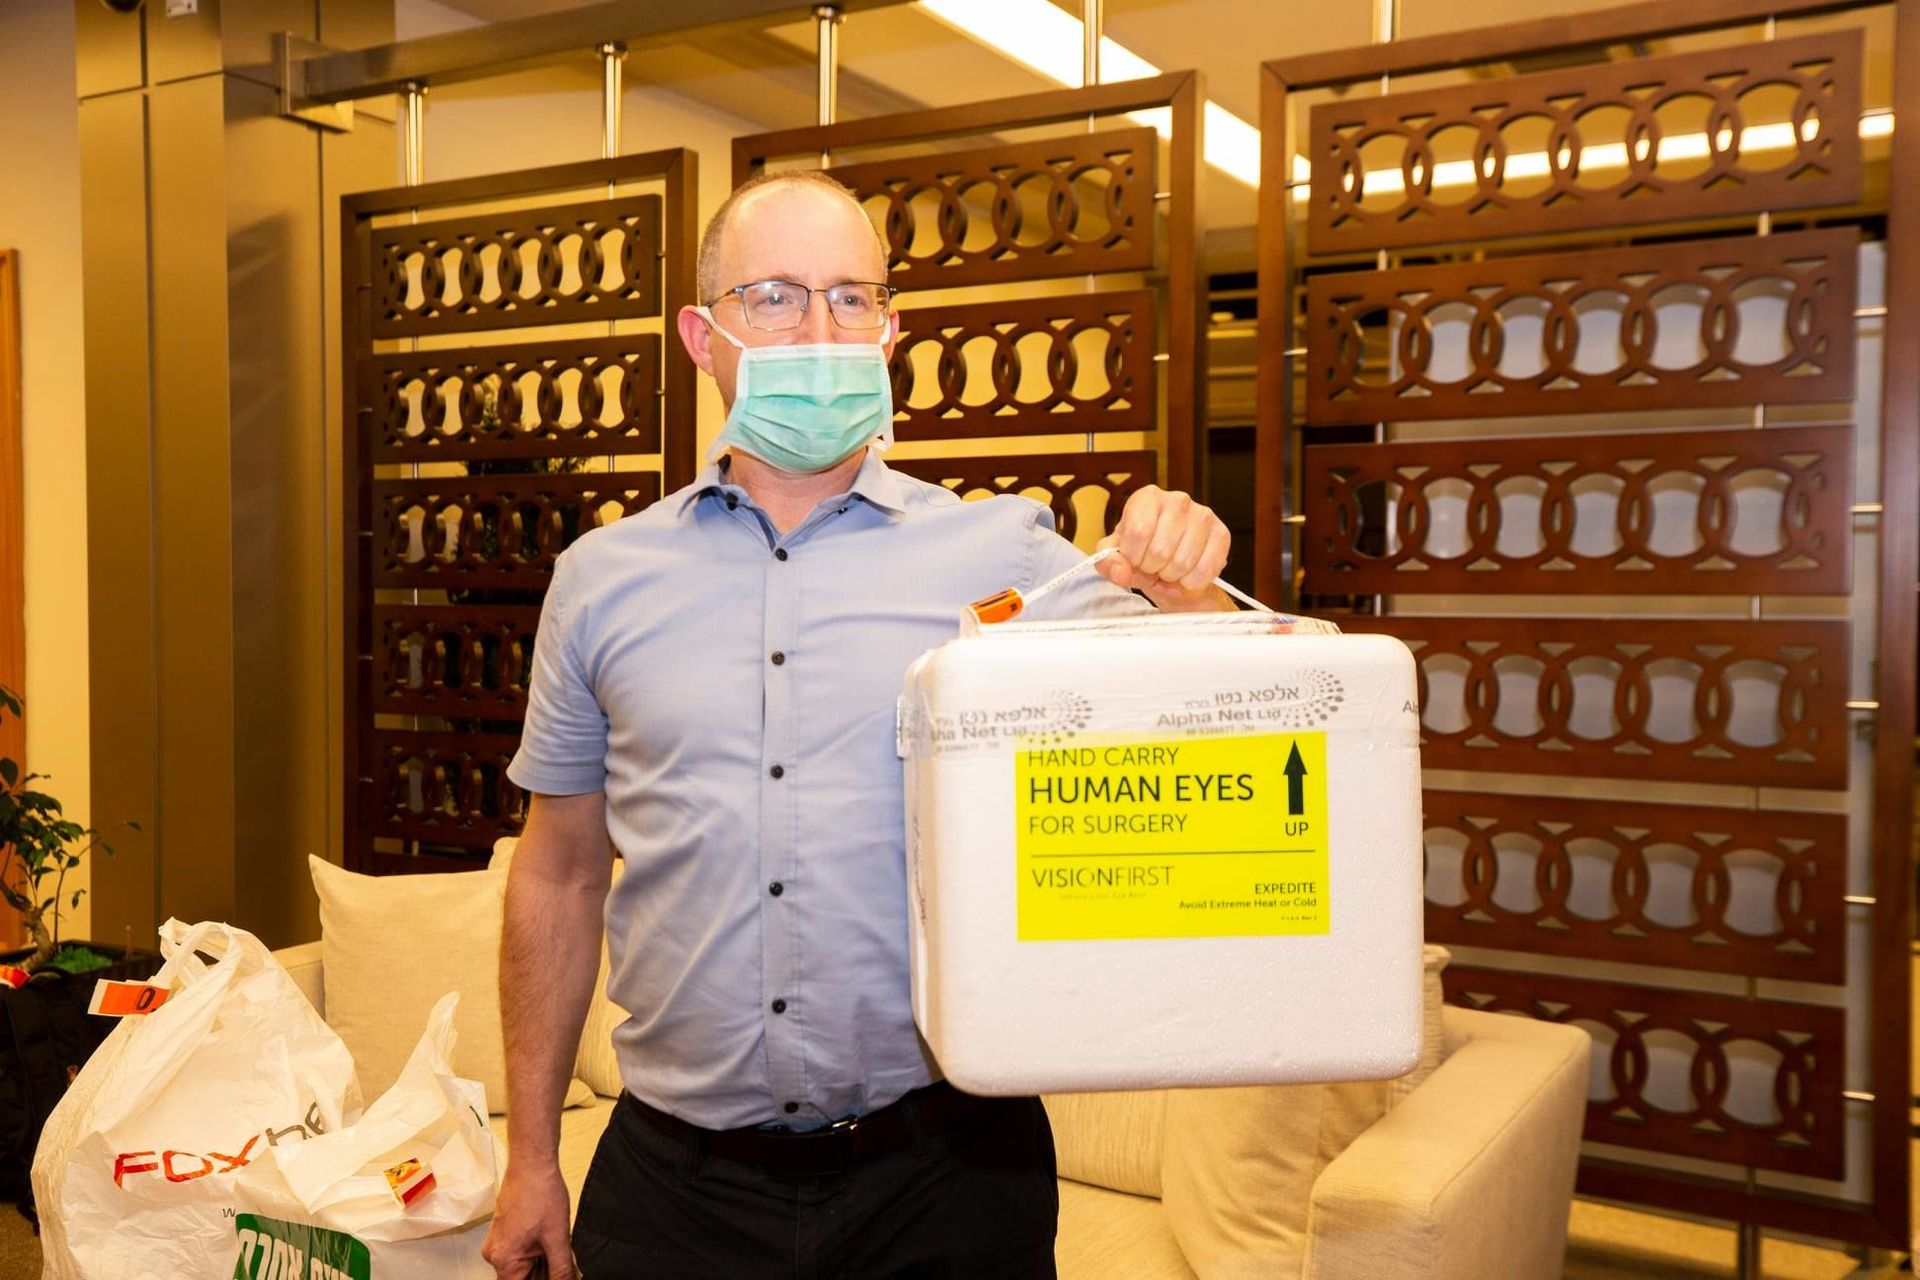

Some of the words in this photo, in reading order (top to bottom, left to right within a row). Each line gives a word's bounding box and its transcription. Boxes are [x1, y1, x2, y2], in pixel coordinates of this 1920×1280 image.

[1249, 684, 1300, 703] אלפא
[994, 704, 1047, 723] אלפא
[1157, 710, 1212, 728] Alpha
[1218, 708, 1252, 722] Net
[962, 725, 996, 738] Net
[1029, 748, 1096, 767] HAND
[1104, 747, 1179, 766] CARRY
[1031, 775, 1160, 803] HUMAN
[1176, 774, 1254, 801] EYES
[1029, 815, 1074, 834] FOR
[1083, 814, 1188, 834] SURGERY
[1285, 821, 1309, 836] UP
[1031, 865, 1175, 888] VISIONFIRST
[1255, 882, 1317, 894] EXPEDITE
[1179, 900, 1207, 909] Avoid
[1210, 900, 1251, 909] Extreme
[1254, 898, 1277, 908] Heat
[1280, 899, 1290, 907] or
[1293, 897, 1317, 907] Cold
[135, 987, 157, 1013] 0
[113, 1134, 261, 1190] FOX
